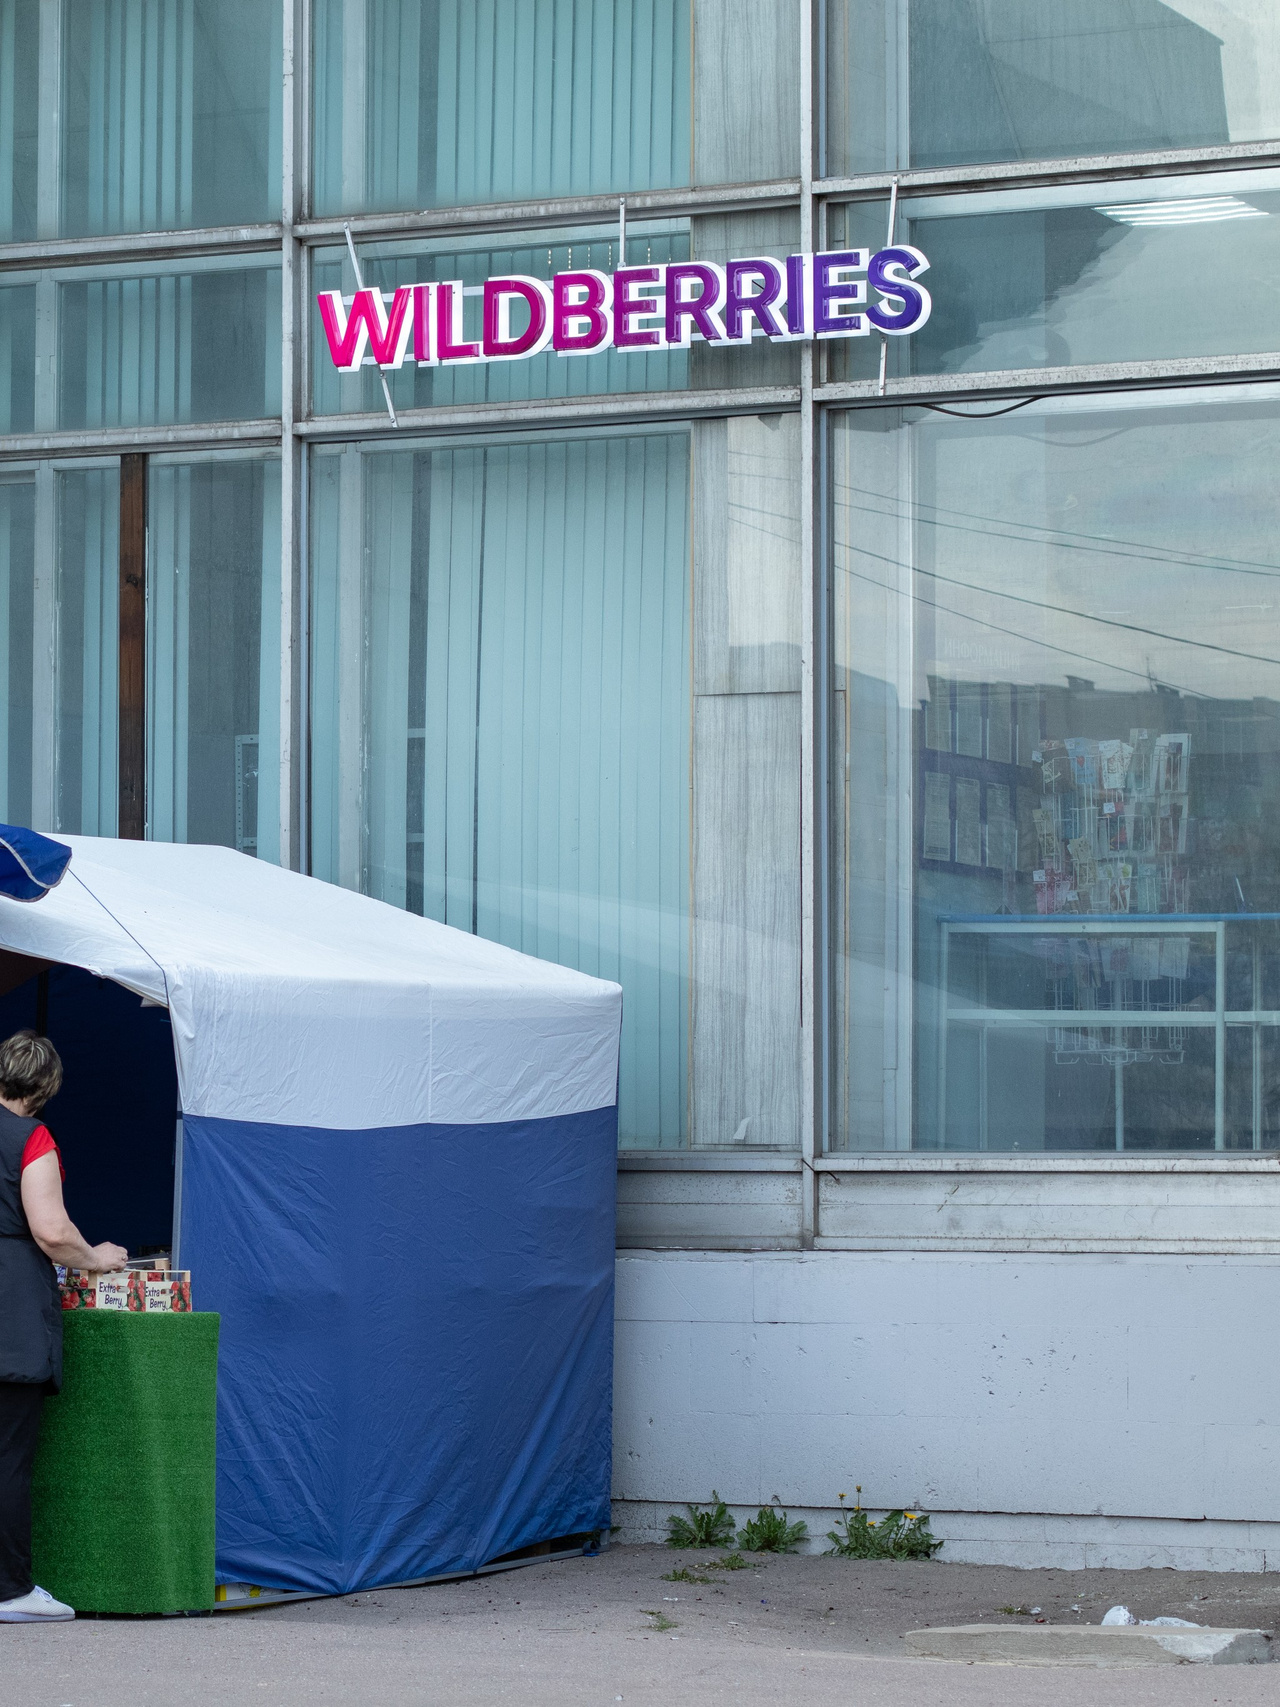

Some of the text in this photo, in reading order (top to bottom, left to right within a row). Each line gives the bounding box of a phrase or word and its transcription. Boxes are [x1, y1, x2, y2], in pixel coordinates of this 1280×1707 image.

[317, 245, 927, 371] WILDBERRIES
[99, 1282, 116, 1294] Extra
[145, 1287, 160, 1297] Extra
